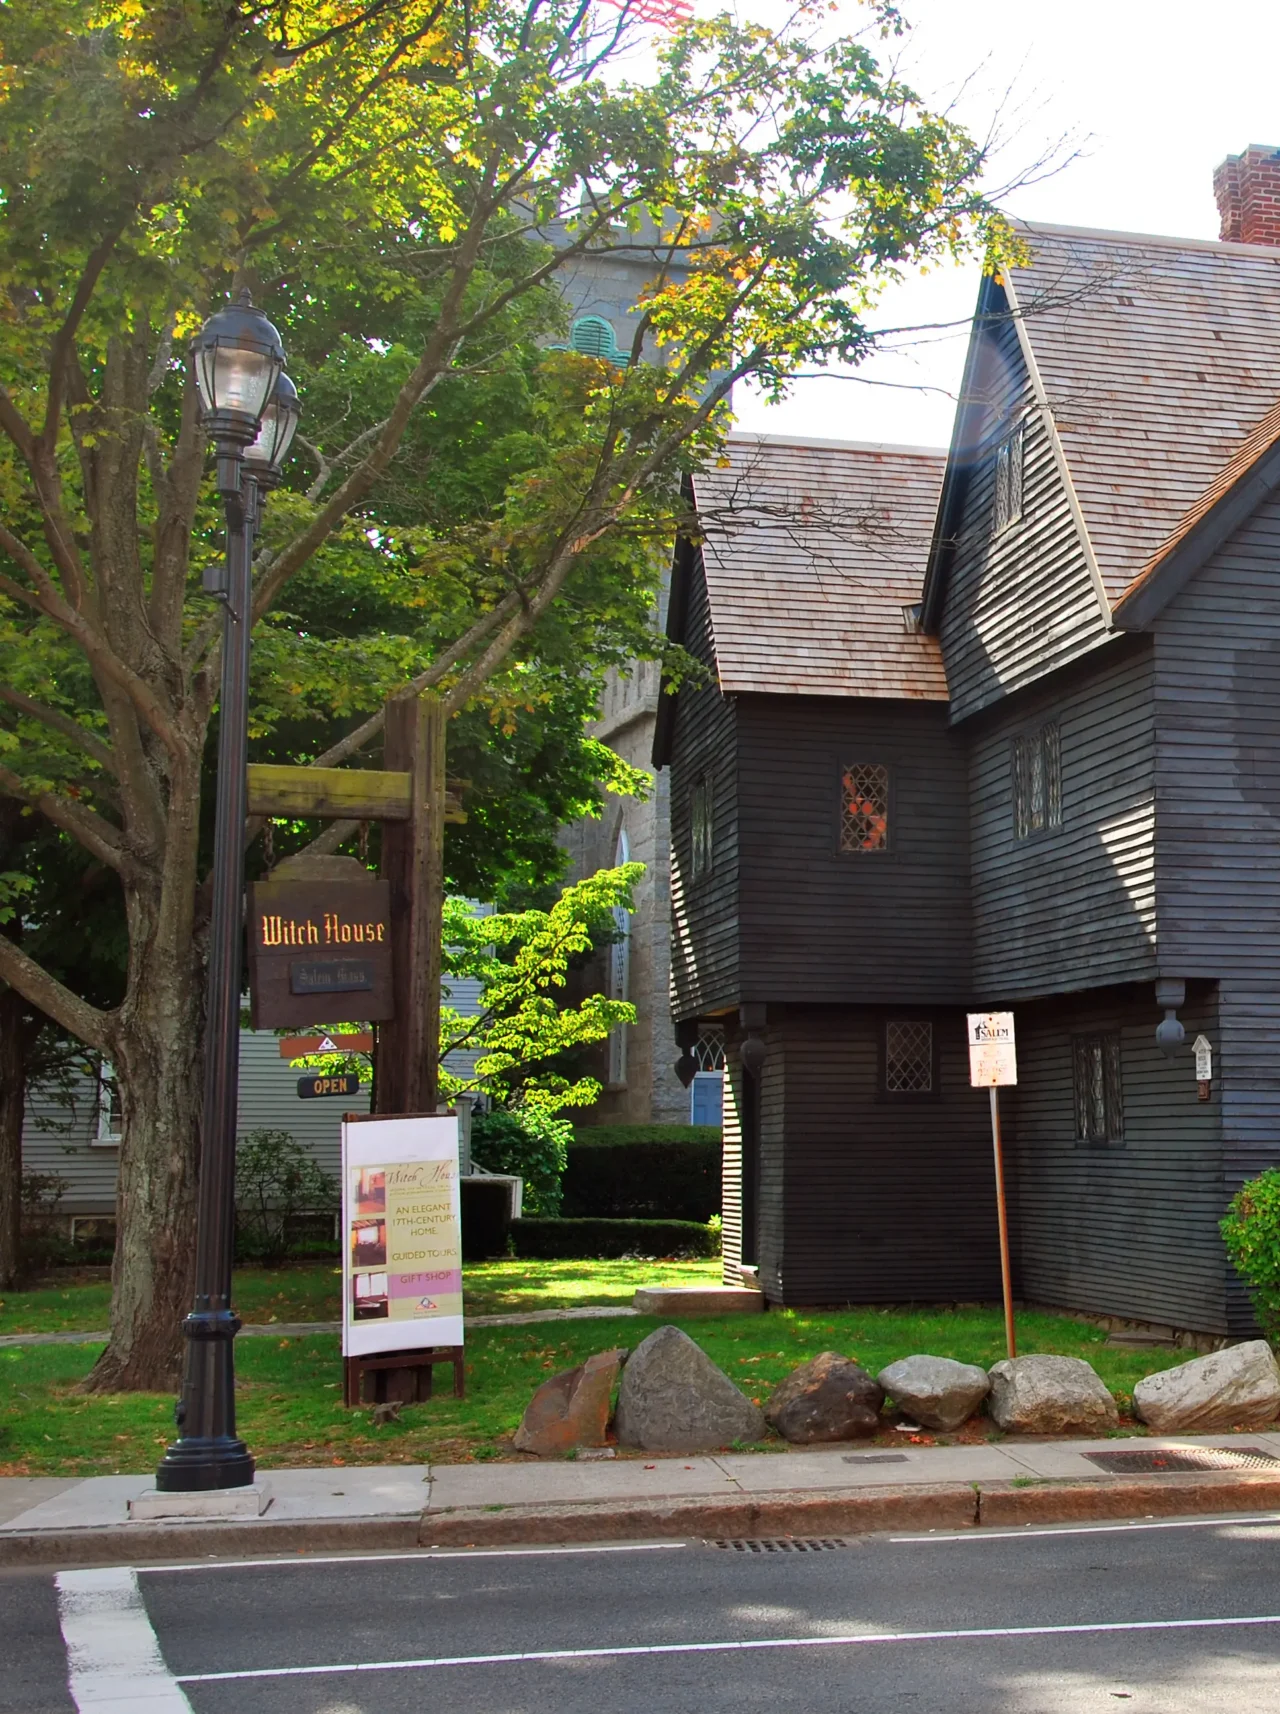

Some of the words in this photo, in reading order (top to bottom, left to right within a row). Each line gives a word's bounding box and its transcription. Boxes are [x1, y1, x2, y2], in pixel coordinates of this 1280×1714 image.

[262, 915, 319, 946] Witch
[323, 913, 385, 944] House
[981, 1029, 1009, 1037] SALEM
[314, 1078, 347, 1094] OPEN
[396, 1206, 410, 1215] AN
[412, 1202, 451, 1214] ELEGANT
[392, 1214, 456, 1227] 17TH-CENTURY
[392, 1250, 426, 1261] GUIDED
[400, 1273, 423, 1284] GIFT
